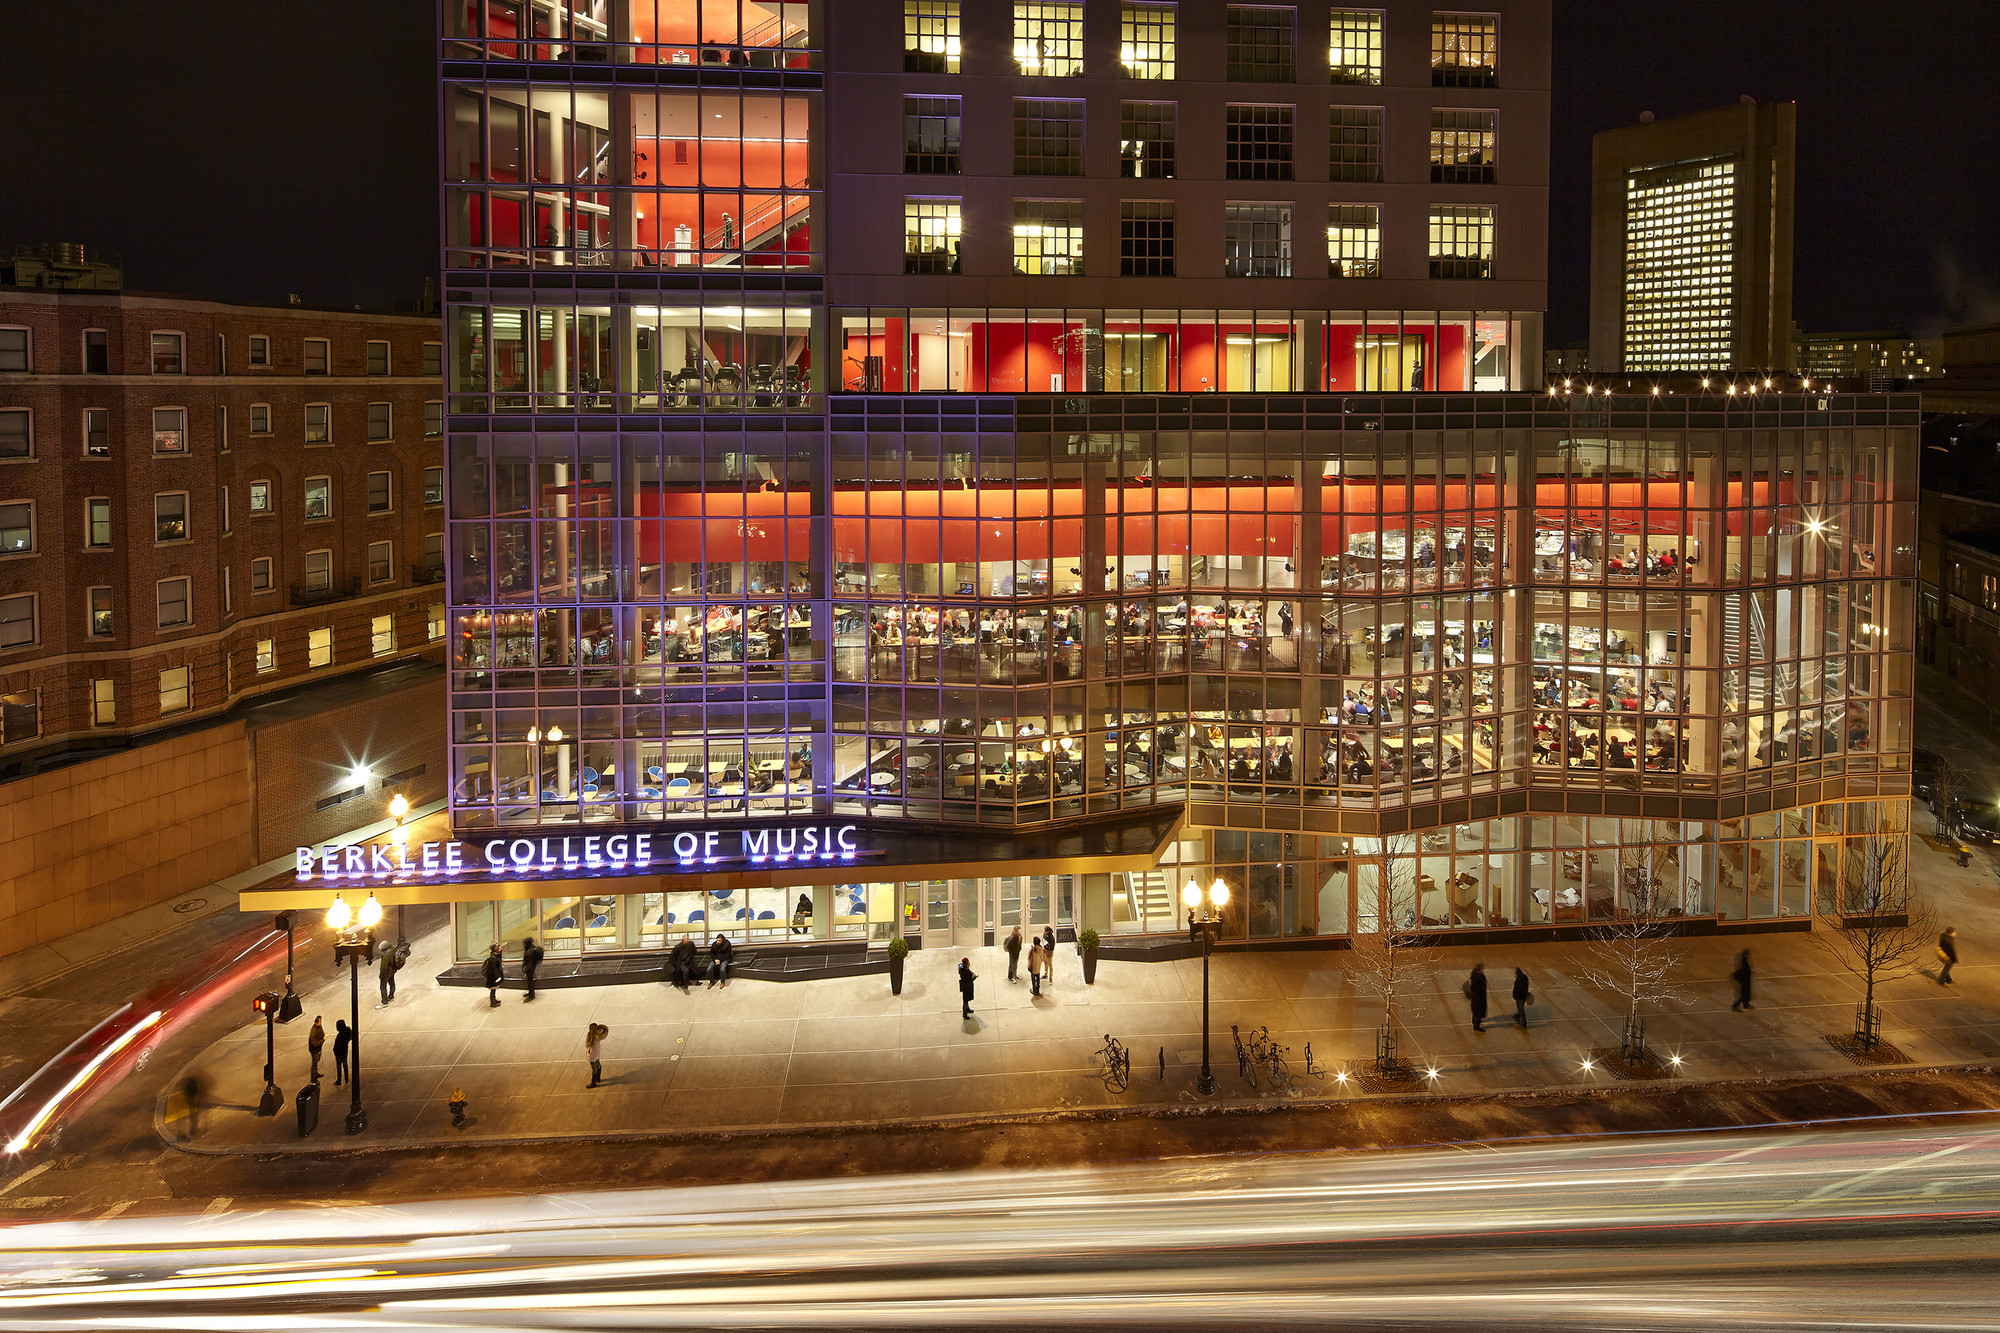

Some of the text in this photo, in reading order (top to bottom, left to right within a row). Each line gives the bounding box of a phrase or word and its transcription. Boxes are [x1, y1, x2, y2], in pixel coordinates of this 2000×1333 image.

[296, 826, 857, 873] BERKLEE COLLEGE OF MUSIC
